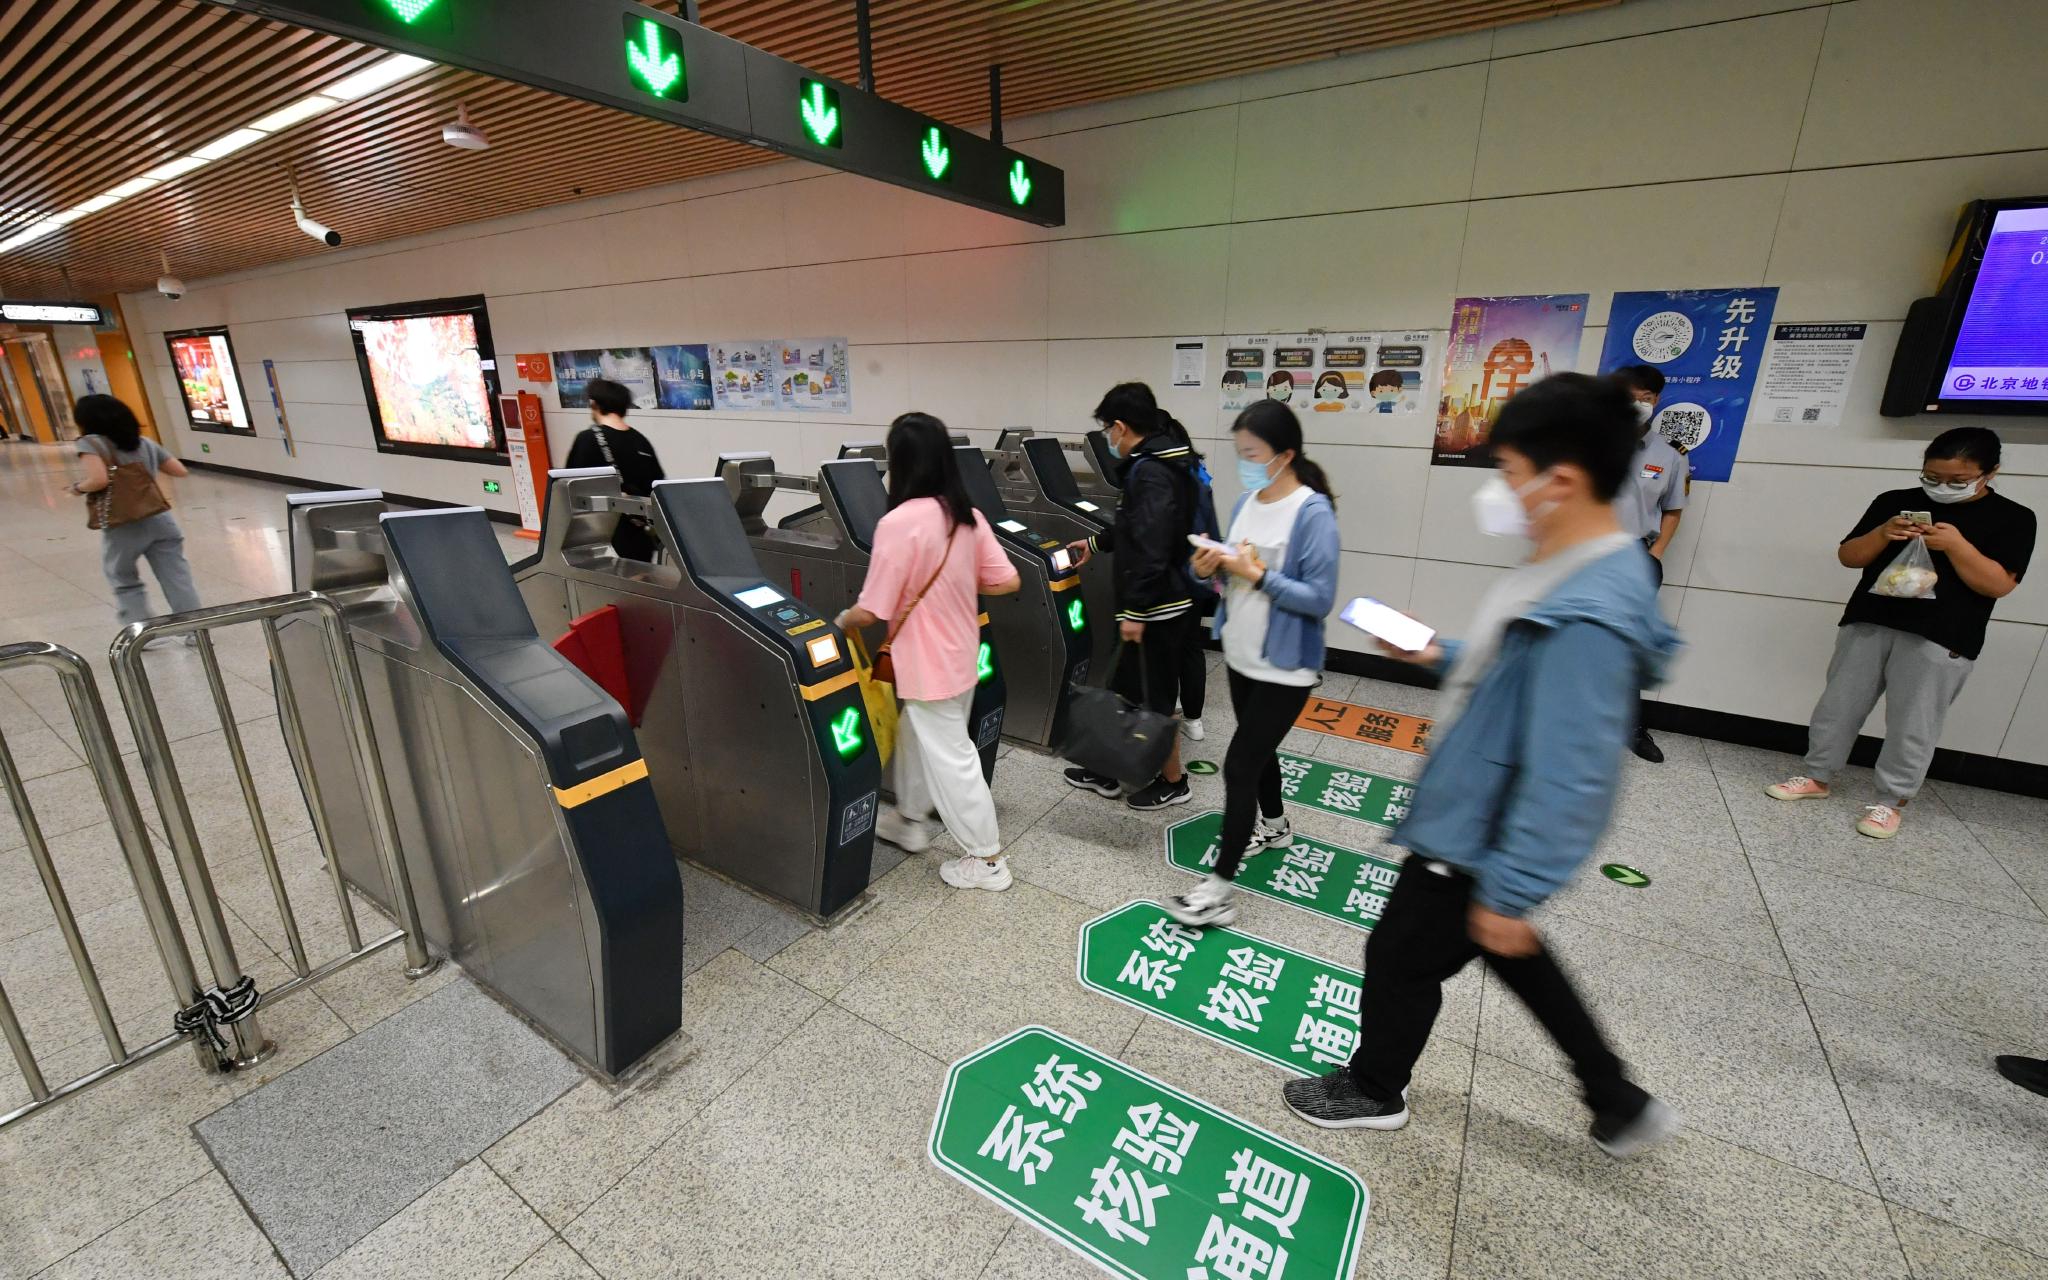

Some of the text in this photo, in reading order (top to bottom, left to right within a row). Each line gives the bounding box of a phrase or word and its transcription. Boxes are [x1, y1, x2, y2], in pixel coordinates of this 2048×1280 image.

[2031, 251, 2048, 265] 0
[1710, 298, 1756, 379] 先升级
[1305, 703, 1348, 731] 人工
[1356, 712, 1399, 742] 服务
[1317, 771, 1372, 811] 核验
[1266, 843, 1336, 900] 核验
[1342, 862, 1400, 920] 通道
[1116, 917, 1204, 1000] 系统
[1198, 946, 1286, 1033] 核验
[1290, 974, 1363, 1067] 通道
[977, 1054, 1102, 1186] 系统
[1073, 1101, 1200, 1246] 核验
[1186, 1148, 1311, 1280] 通道
